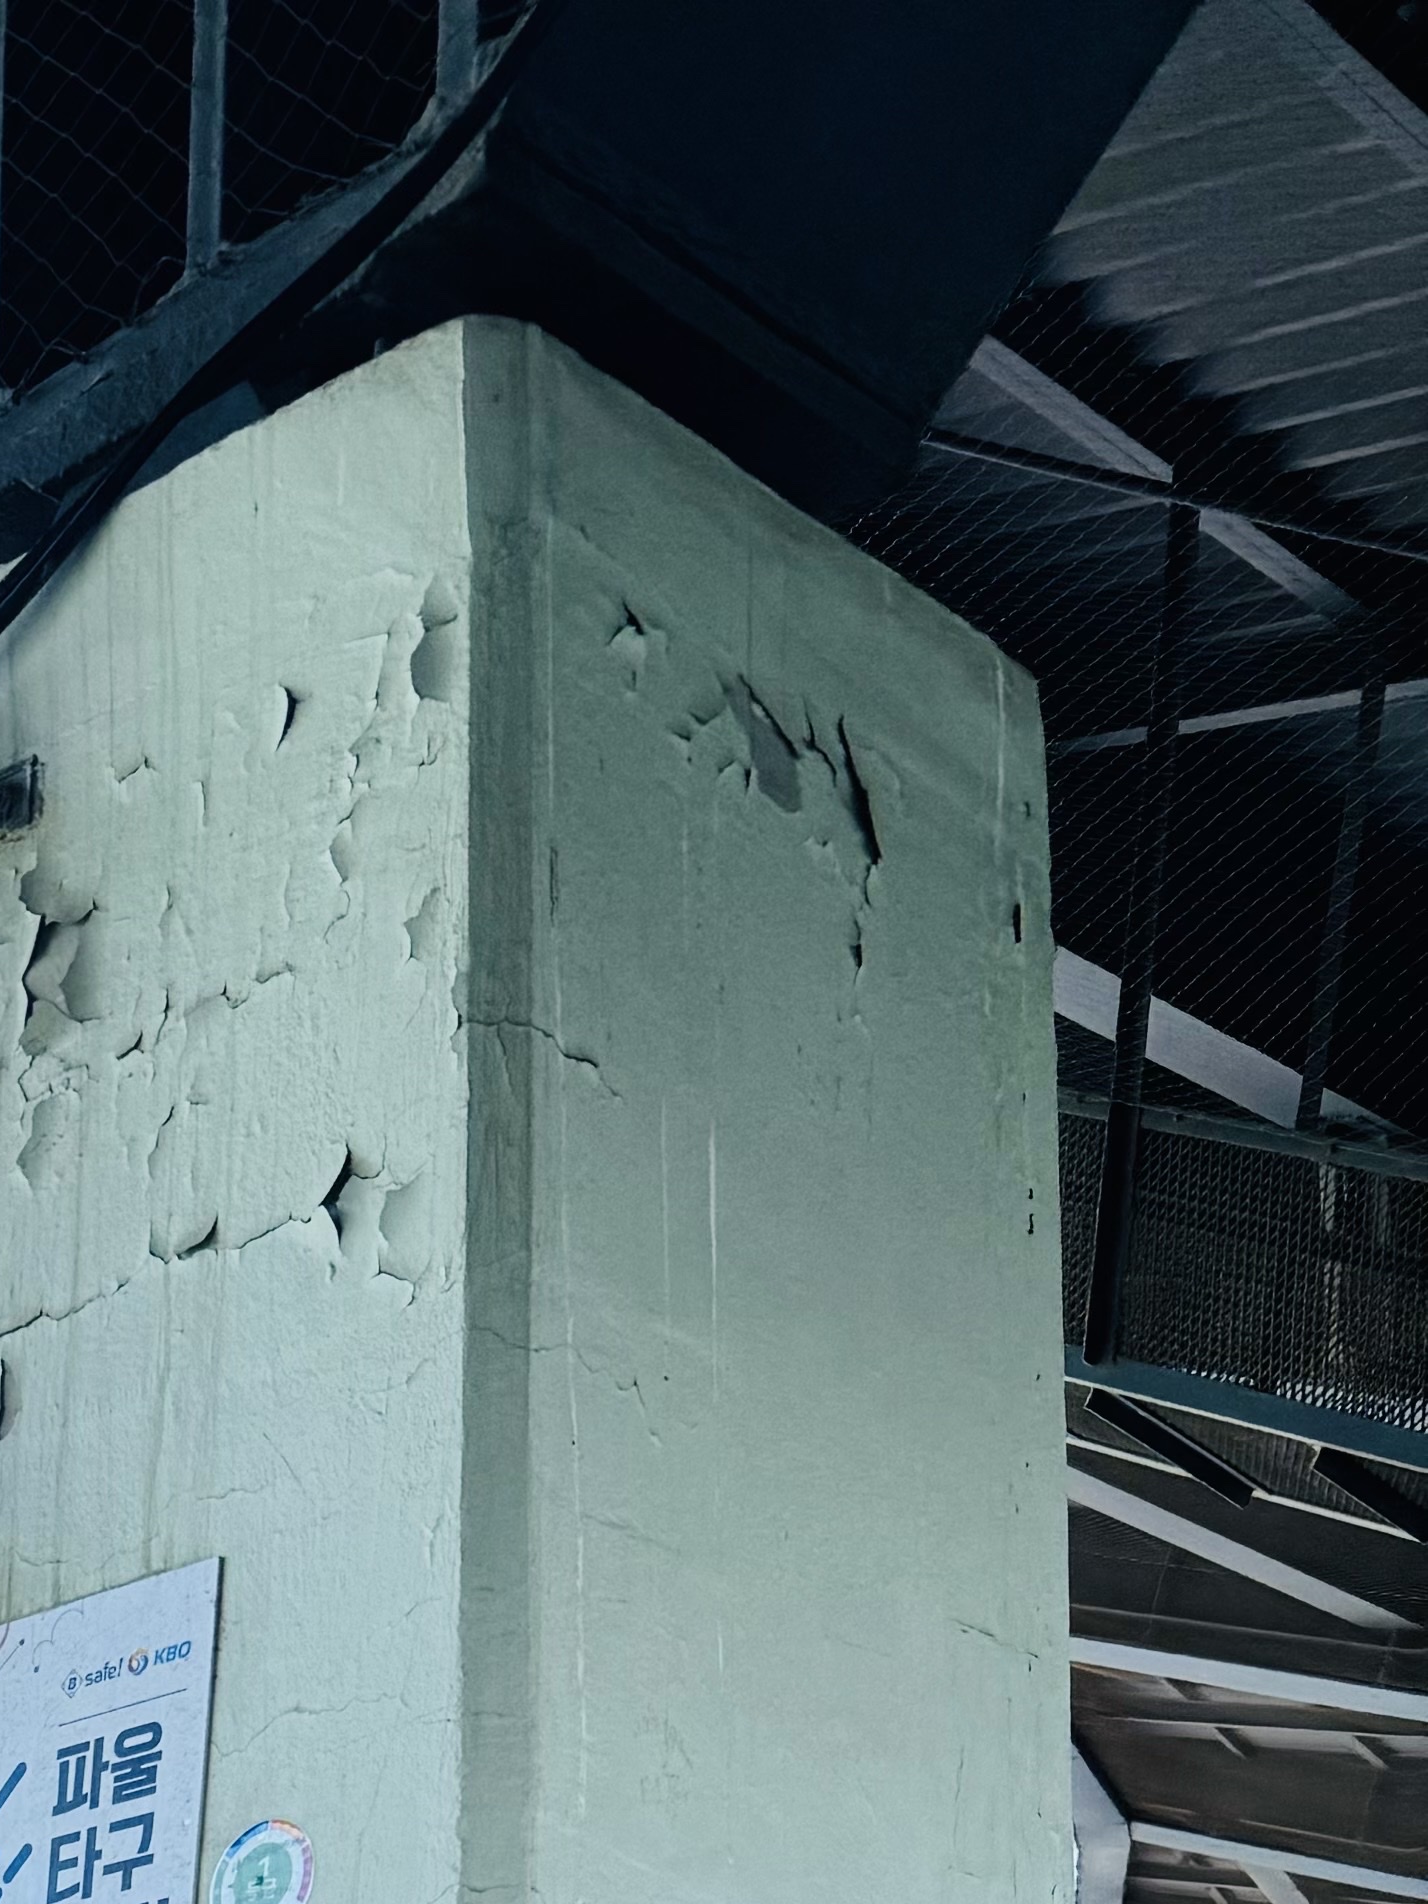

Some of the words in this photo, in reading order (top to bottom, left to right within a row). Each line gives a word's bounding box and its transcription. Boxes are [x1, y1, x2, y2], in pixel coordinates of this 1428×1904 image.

[84, 1657, 124, 1688] safe!
[153, 1640, 192, 1666] KBO
[51, 1720, 163, 1817] 파울
[45, 1811, 155, 1904] 타구
